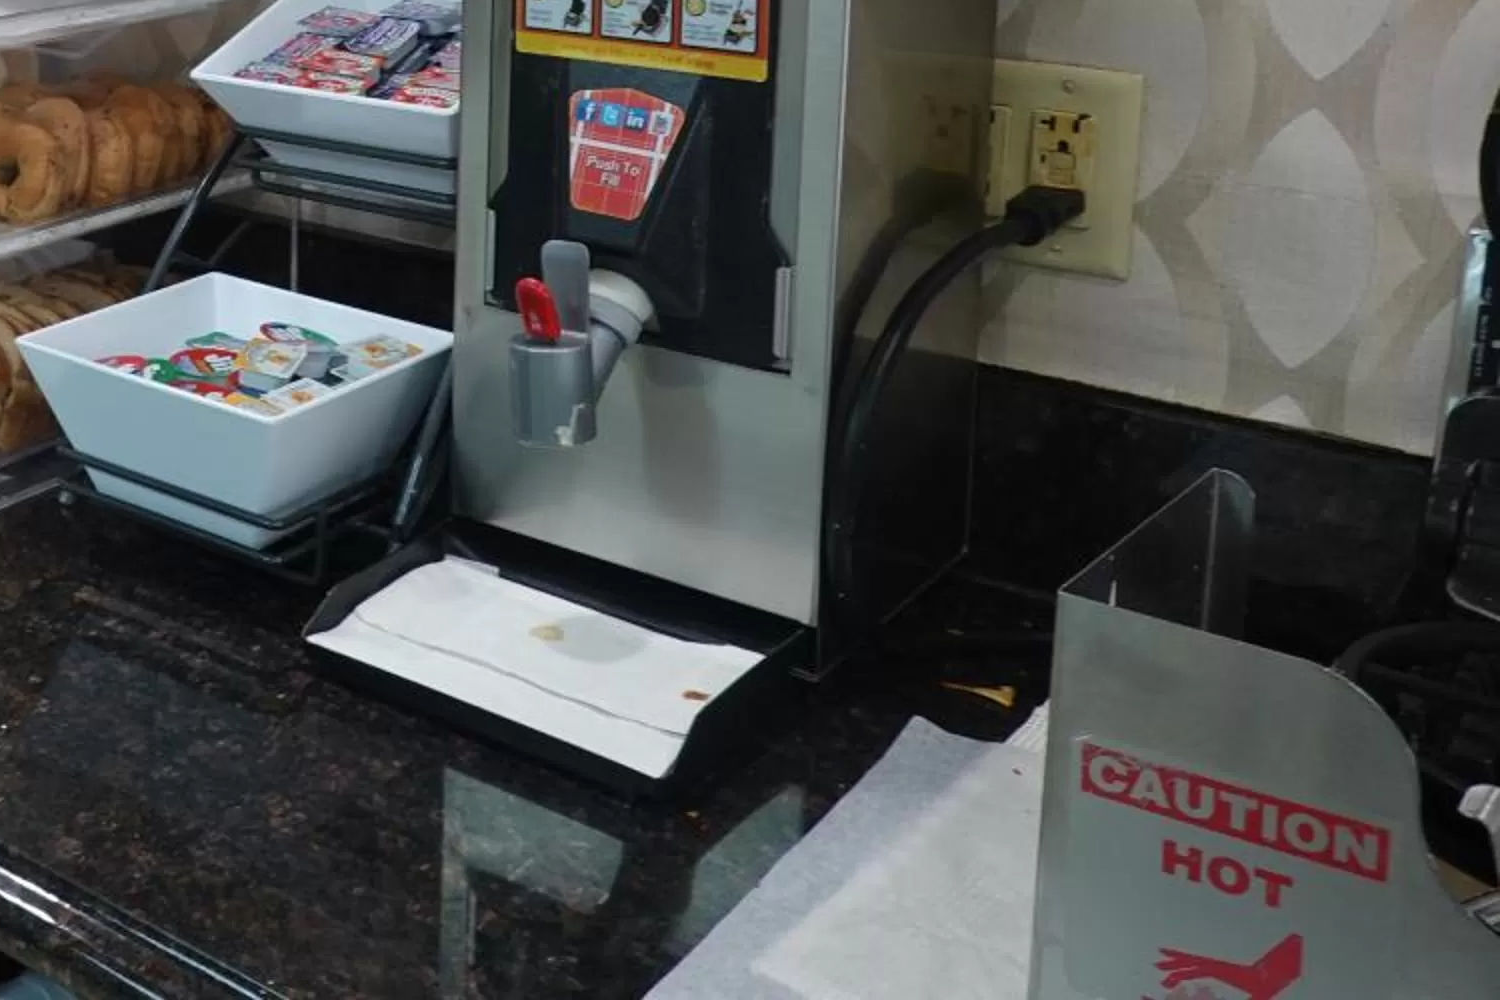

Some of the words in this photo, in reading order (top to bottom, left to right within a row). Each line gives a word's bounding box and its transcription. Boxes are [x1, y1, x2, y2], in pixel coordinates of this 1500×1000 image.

[586, 155, 621, 172] Push
[623, 162, 642, 178] To
[599, 171, 621, 187] Fill
[1089, 753, 1380, 871] CAUTION
[1162, 839, 1293, 908] HOT
